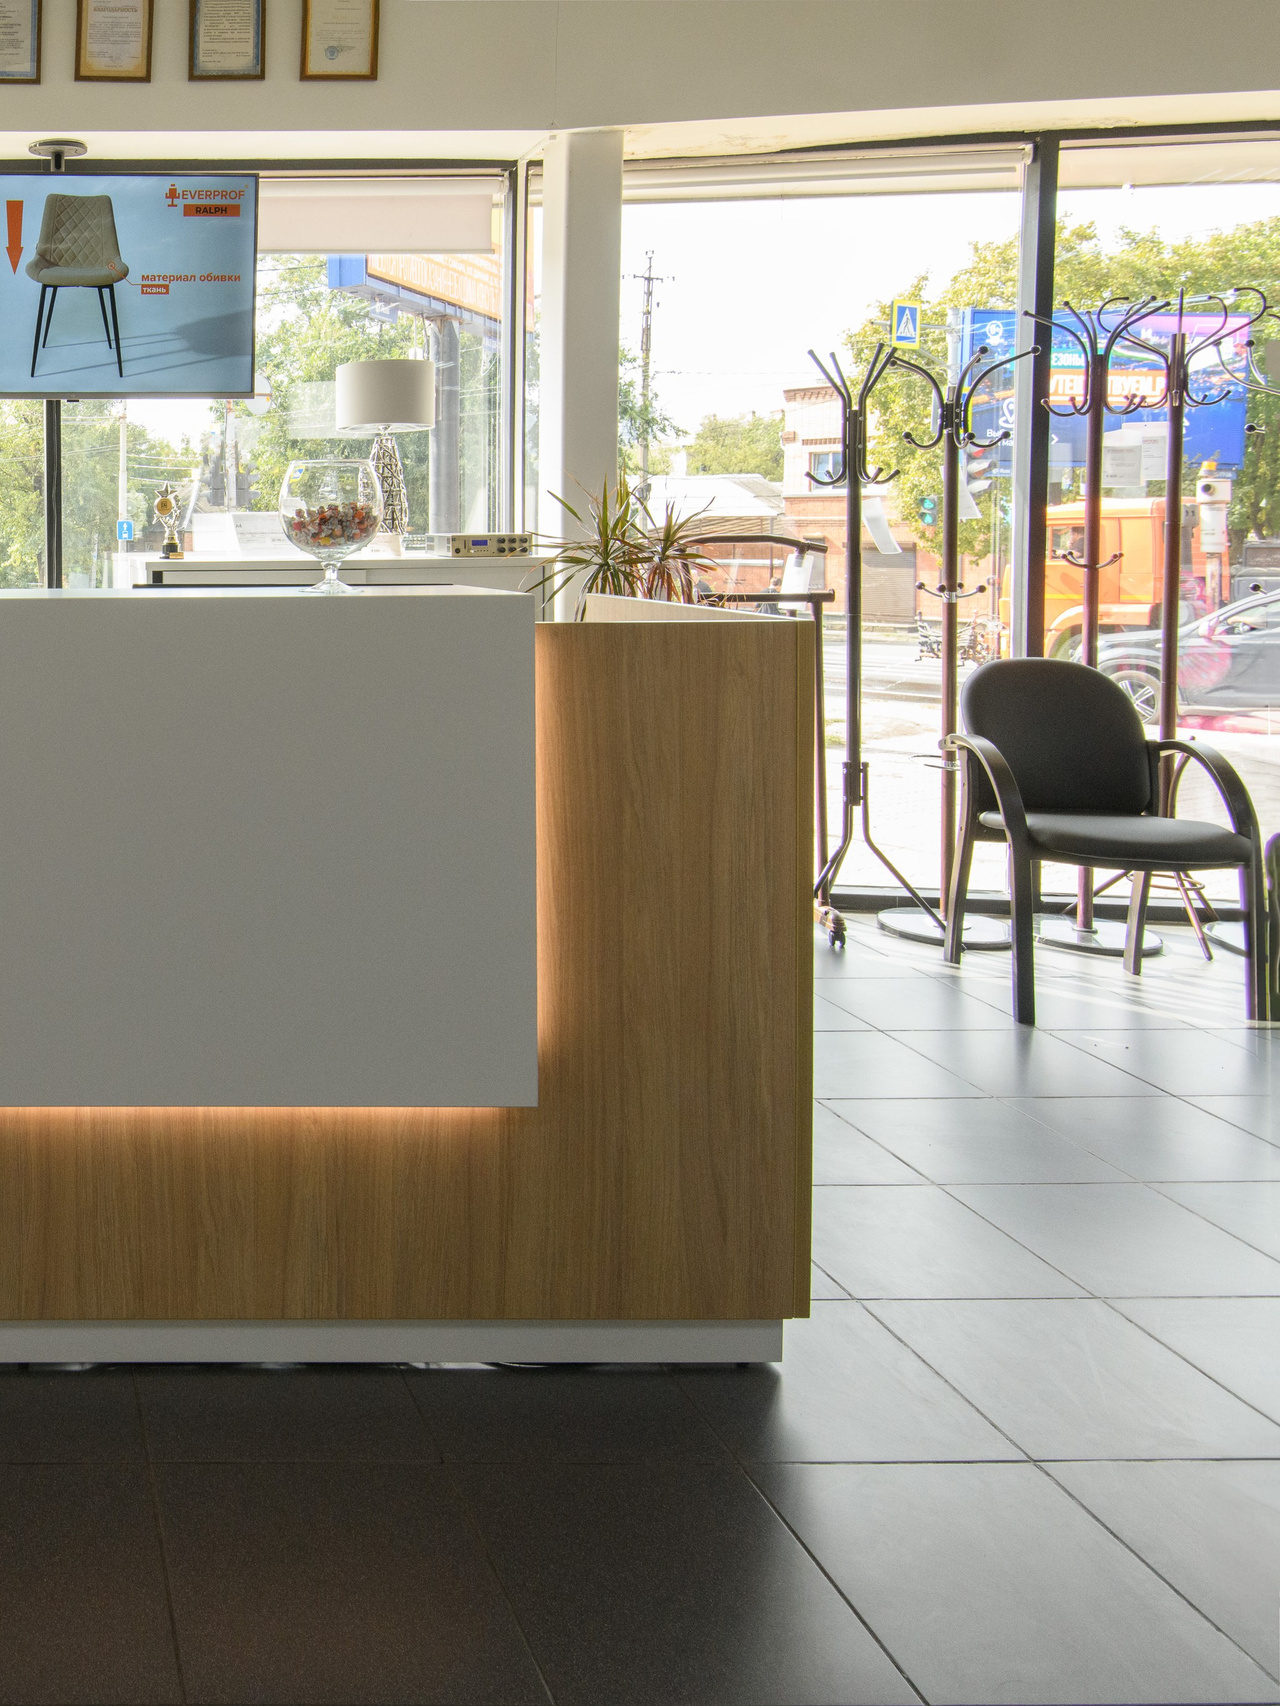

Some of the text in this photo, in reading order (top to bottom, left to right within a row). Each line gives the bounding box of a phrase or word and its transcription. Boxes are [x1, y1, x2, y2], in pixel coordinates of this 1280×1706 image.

[181, 189, 245, 200] EVERPROF
[195, 206, 228, 215] RALPH
[141, 273, 241, 284] материал обивки
[142, 286, 167, 294] ткань
